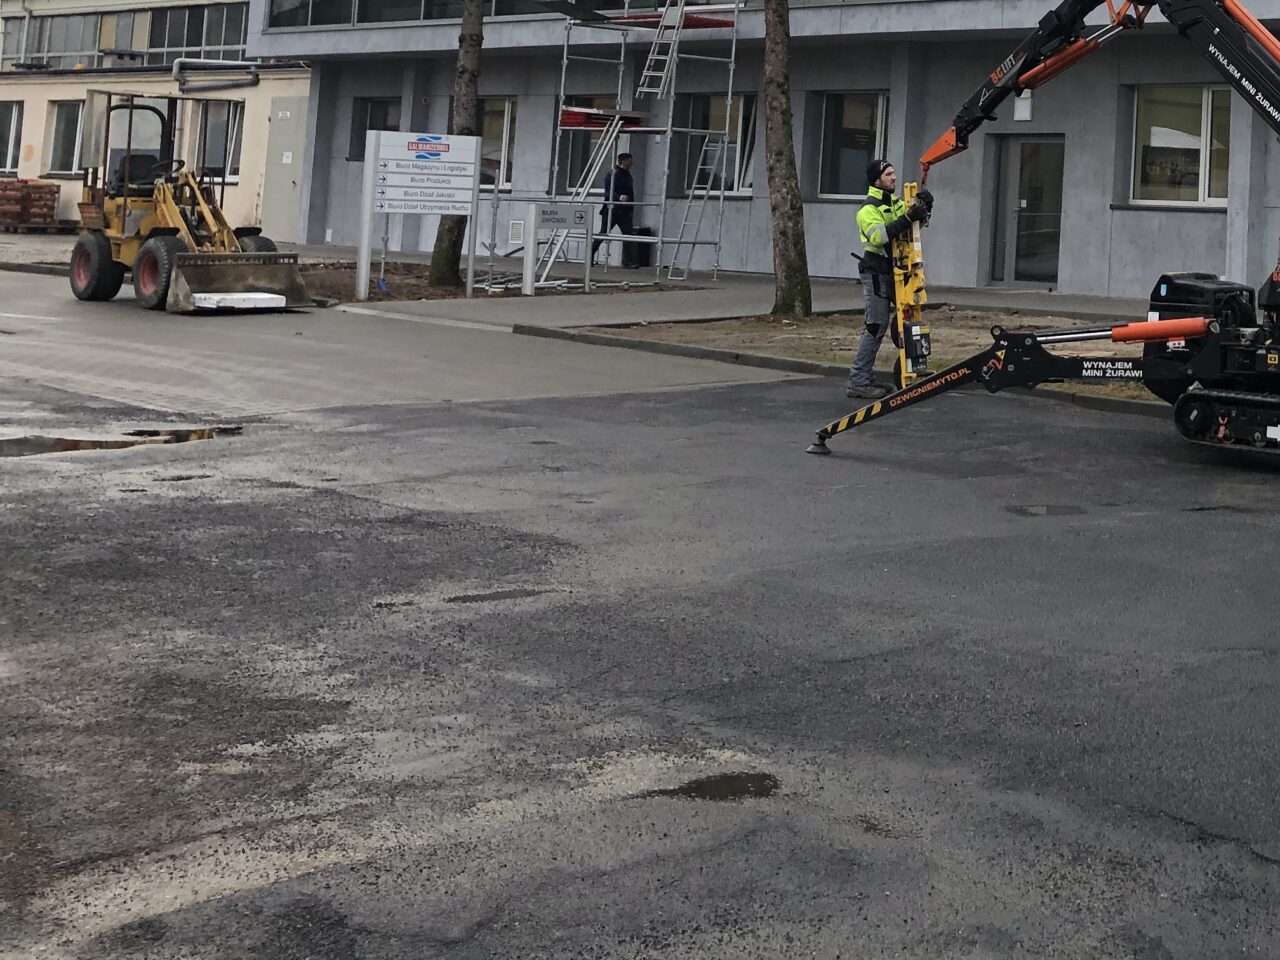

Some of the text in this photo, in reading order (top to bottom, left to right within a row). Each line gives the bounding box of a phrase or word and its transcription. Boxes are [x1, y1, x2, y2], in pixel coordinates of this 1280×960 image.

[1208, 43, 1241, 80] WYNAJEM
[1240, 77, 1257, 96] MINI
[1082, 368, 1143, 378] MINI ŻURAWI
[1083, 361, 1133, 370] WYNAJEM
[889, 367, 972, 408] DZWIGNIEMYTO.PL
